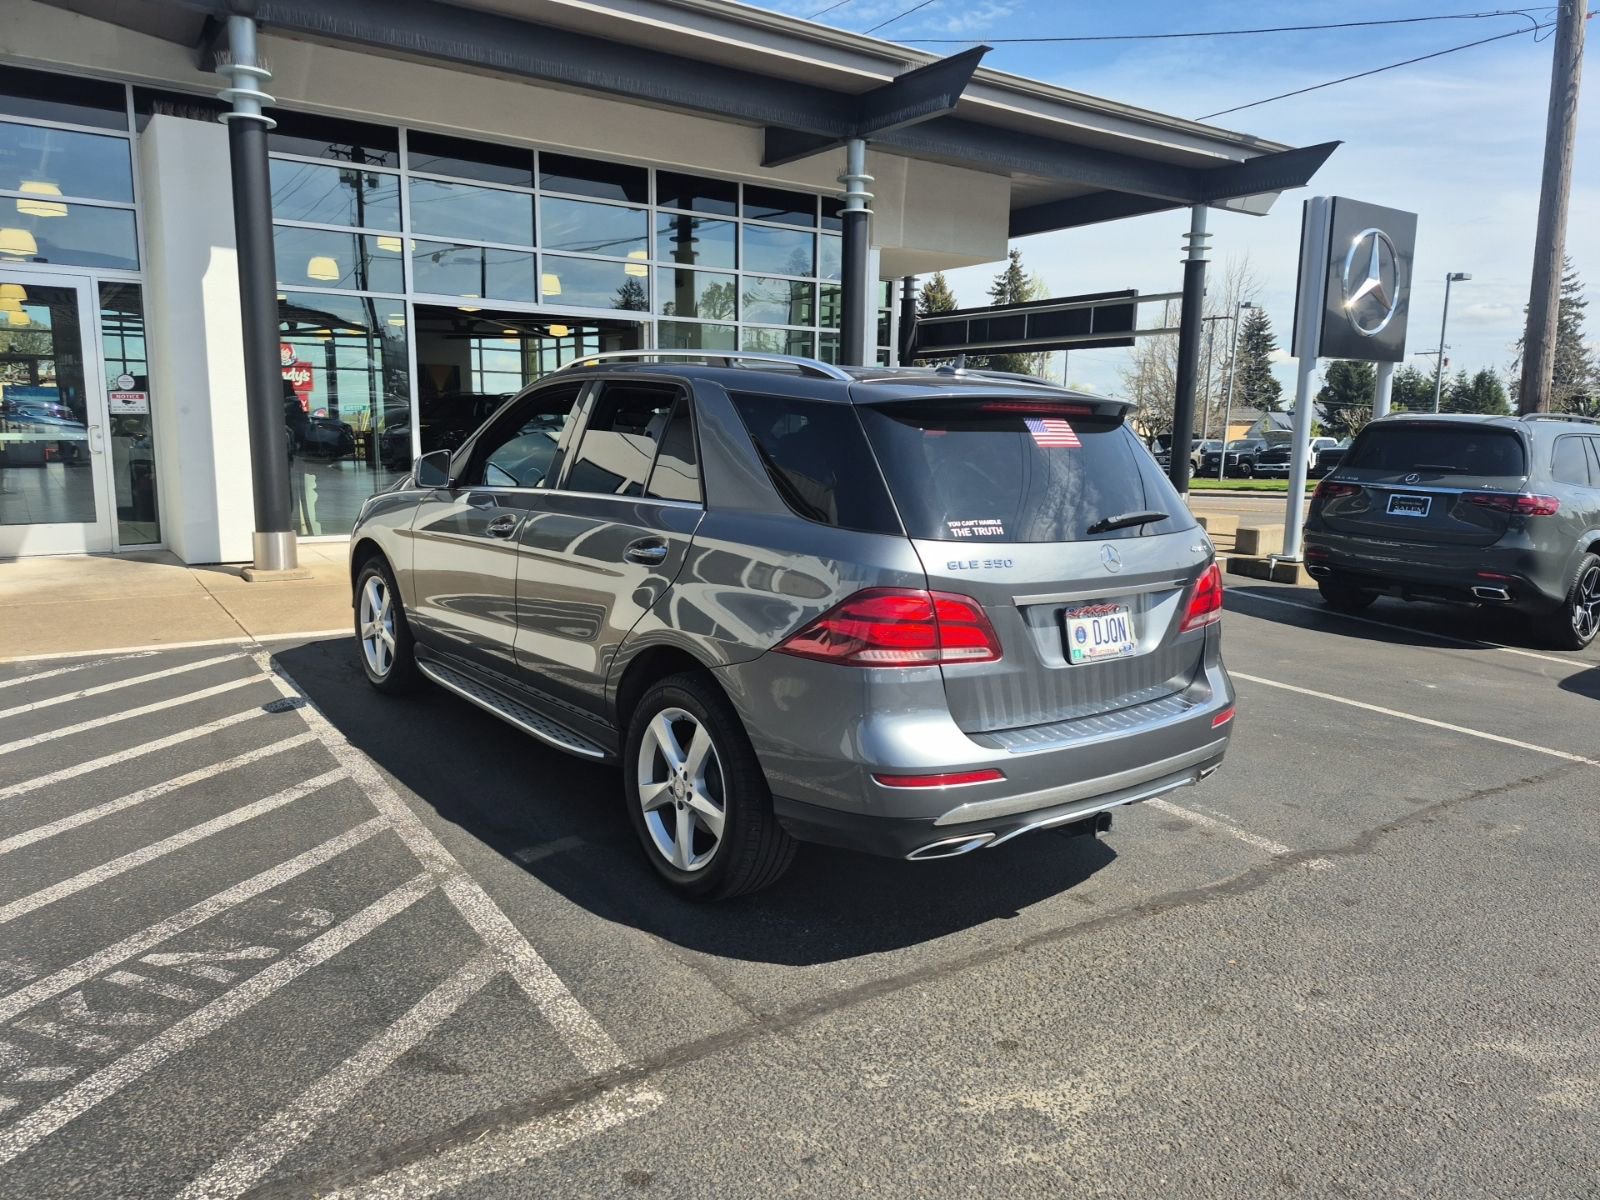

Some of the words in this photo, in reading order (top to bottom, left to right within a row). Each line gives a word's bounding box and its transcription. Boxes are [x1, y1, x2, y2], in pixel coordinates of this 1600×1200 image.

[961, 519, 979, 527] CAN'T
[950, 527, 973, 537] THE
[972, 526, 1005, 536] TRUTH
[946, 560, 980, 571] GLE
[983, 559, 1014, 569] 350
